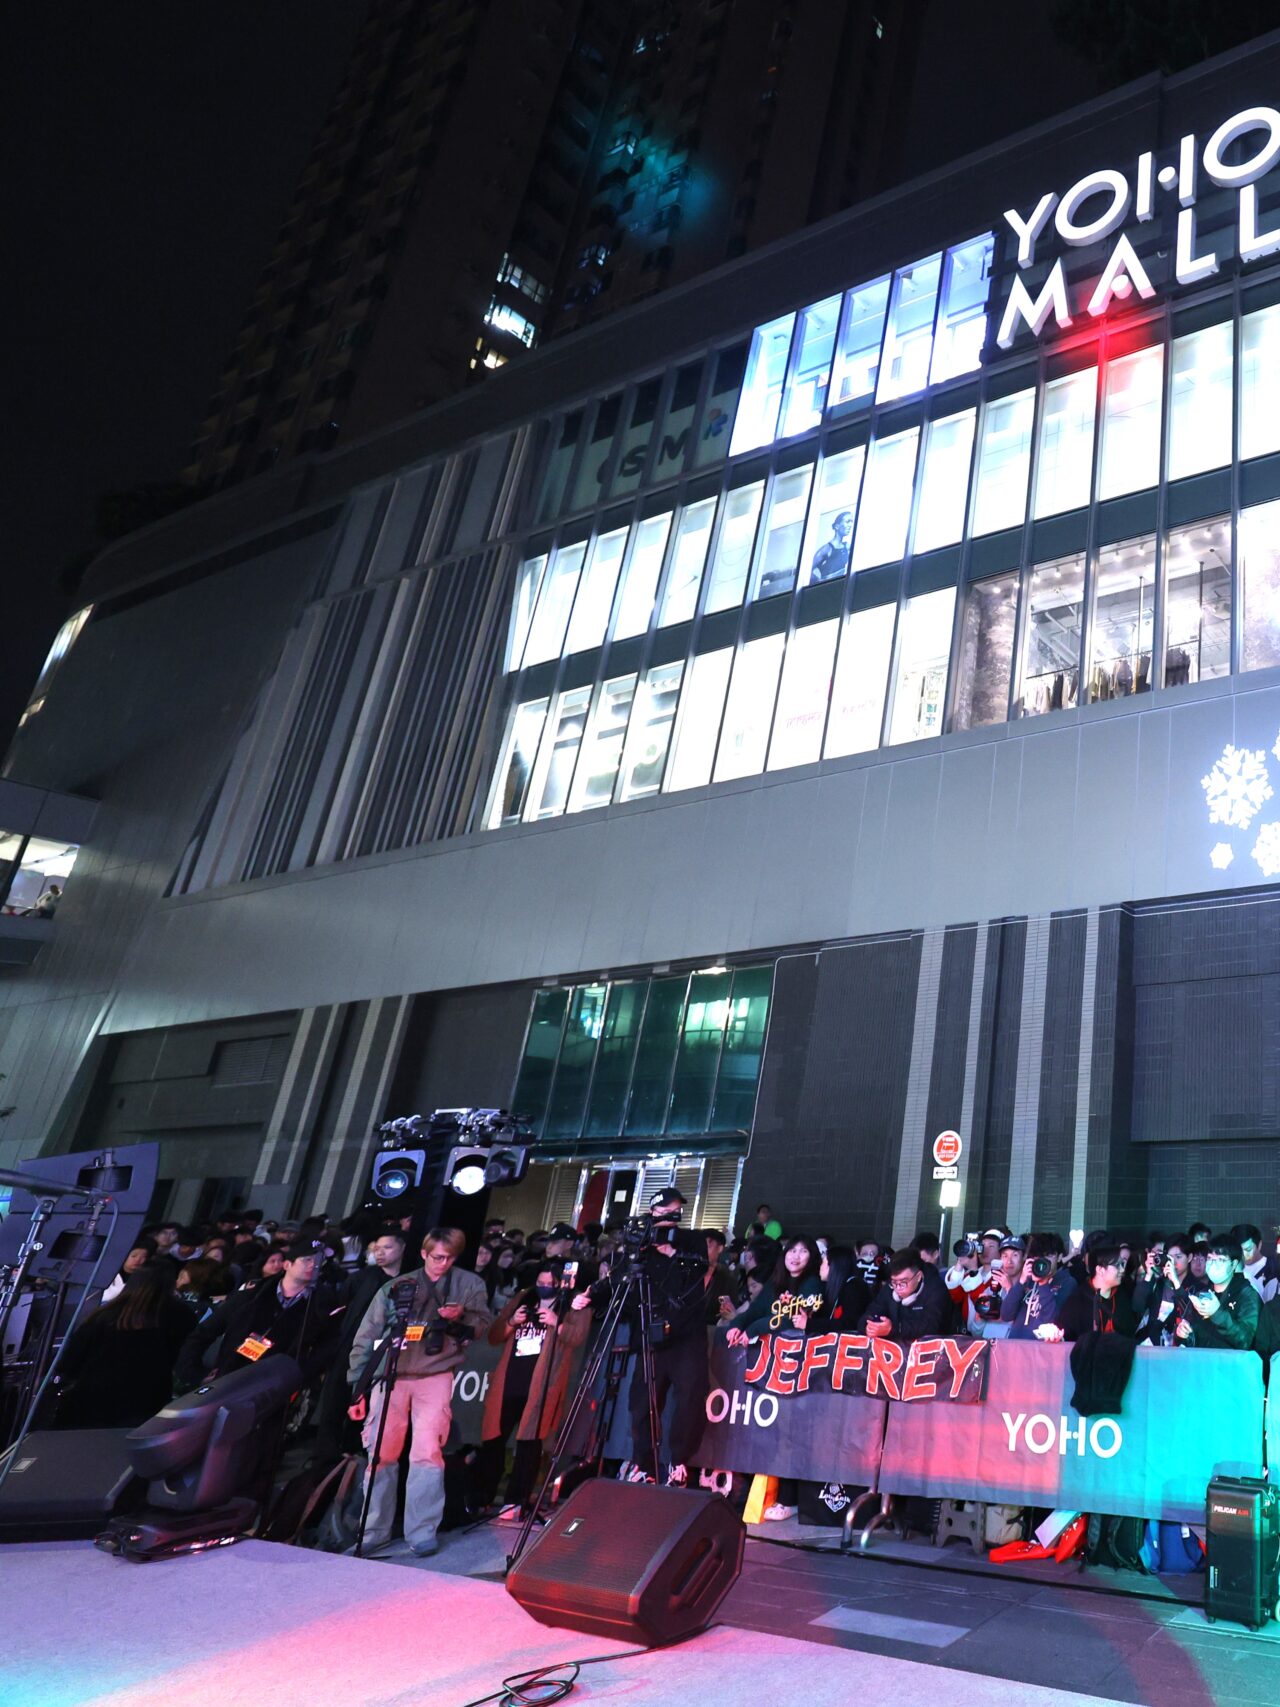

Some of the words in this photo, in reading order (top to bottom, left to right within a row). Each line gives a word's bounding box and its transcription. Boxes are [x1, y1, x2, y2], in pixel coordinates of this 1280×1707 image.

[744, 1332, 988, 1401] JEFFREY
[706, 1389, 779, 1428] OHO
[1002, 1412, 1122, 1459] YOHO
[1213, 1505, 1238, 1515] PELICAN
